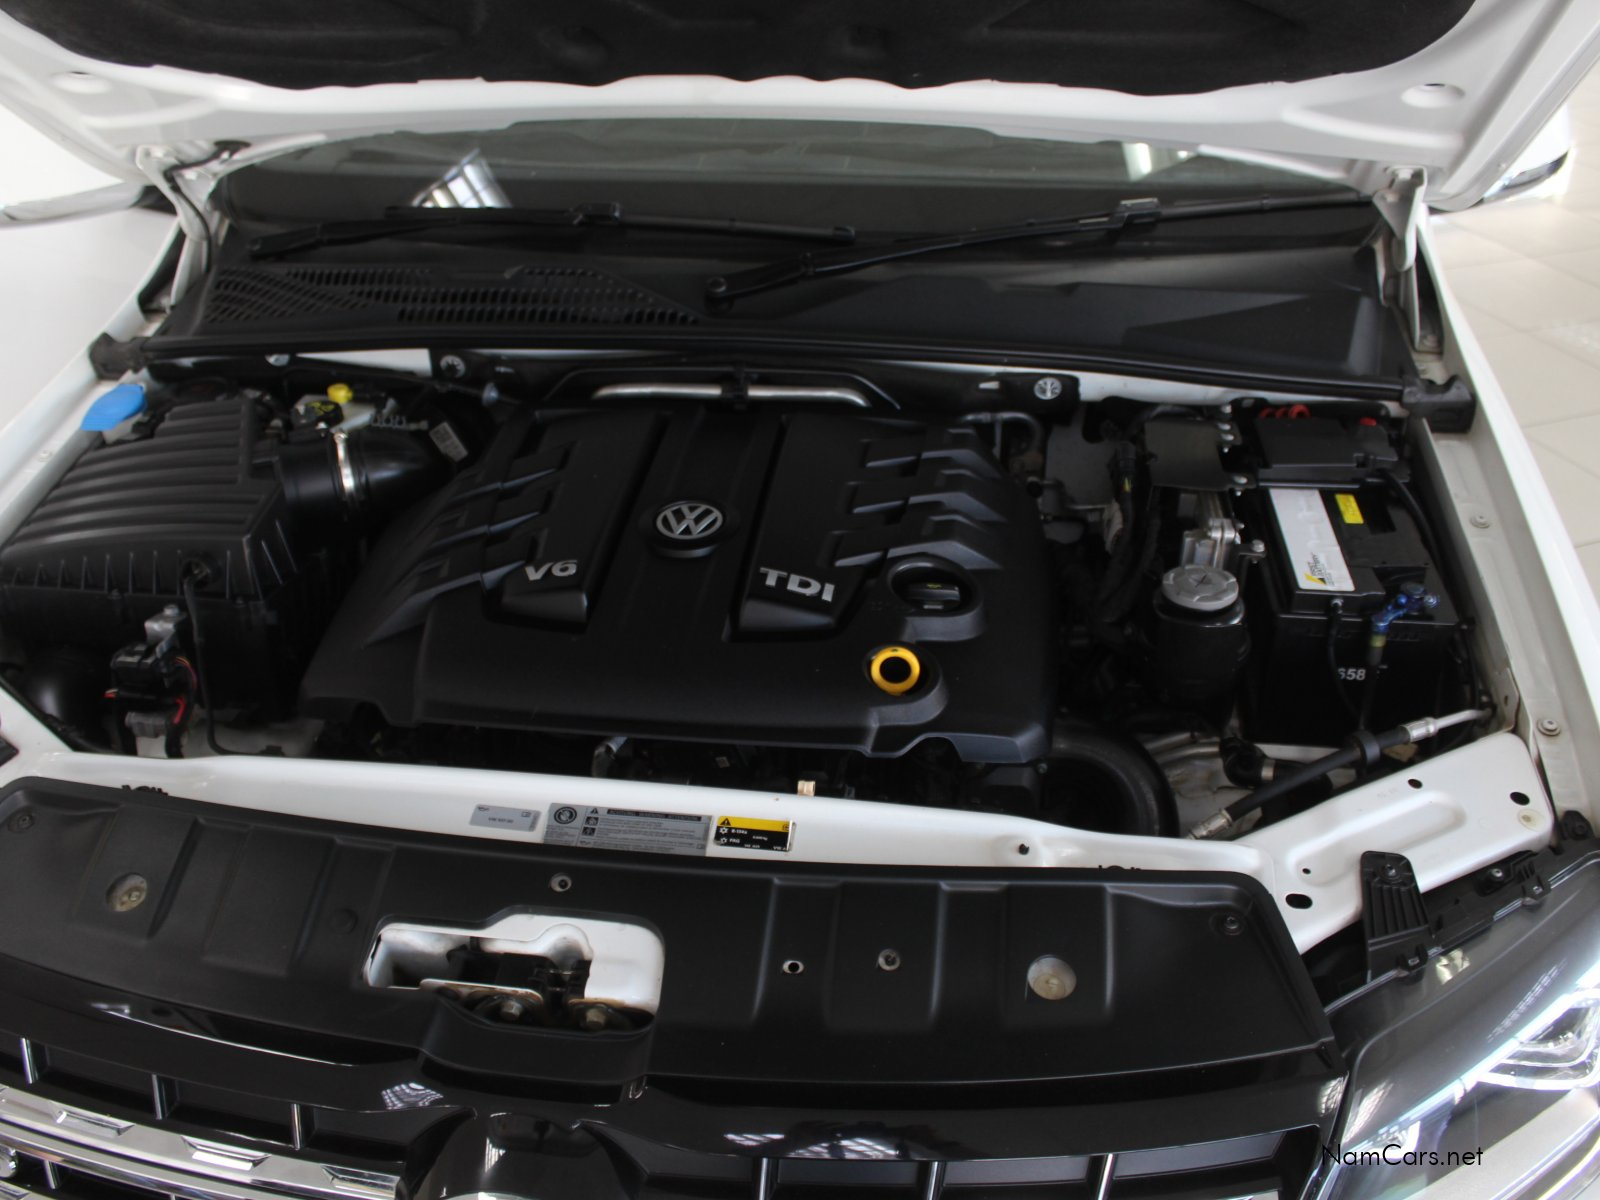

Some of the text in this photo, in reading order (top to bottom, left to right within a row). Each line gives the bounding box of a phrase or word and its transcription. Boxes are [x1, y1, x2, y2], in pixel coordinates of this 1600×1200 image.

[656, 502, 723, 540] VW
[524, 559, 578, 581] V6
[759, 567, 836, 603] TDI
